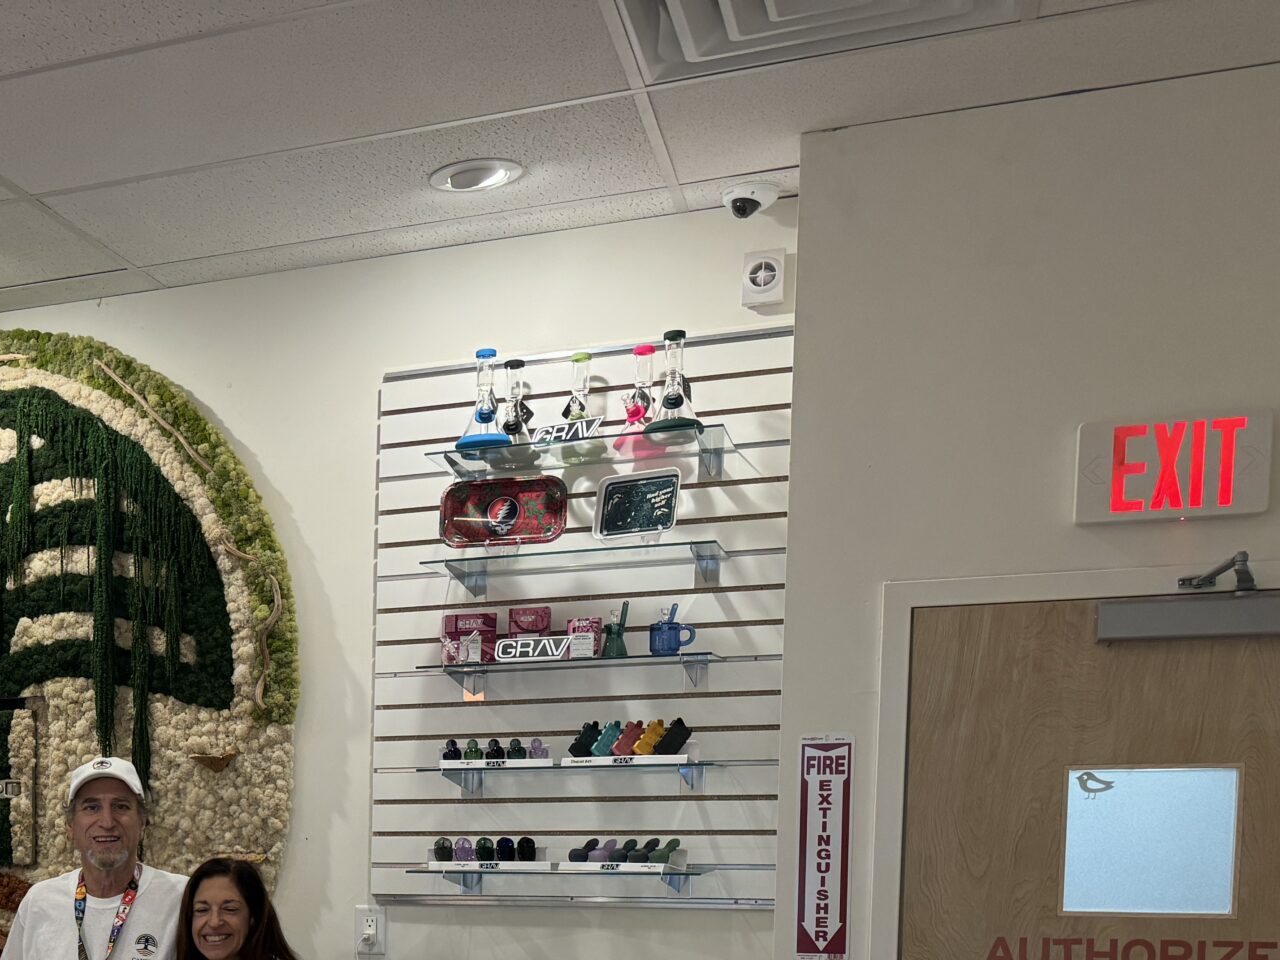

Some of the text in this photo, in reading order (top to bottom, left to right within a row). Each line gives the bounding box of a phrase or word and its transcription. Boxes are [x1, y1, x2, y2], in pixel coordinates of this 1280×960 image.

[535, 417, 601, 442] GRAV
[1110, 416, 1248, 514] EXIT
[499, 638, 569, 657] GRAV
[806, 755, 846, 775] FIRE
[815, 779, 833, 942] EXTINGUISHER
